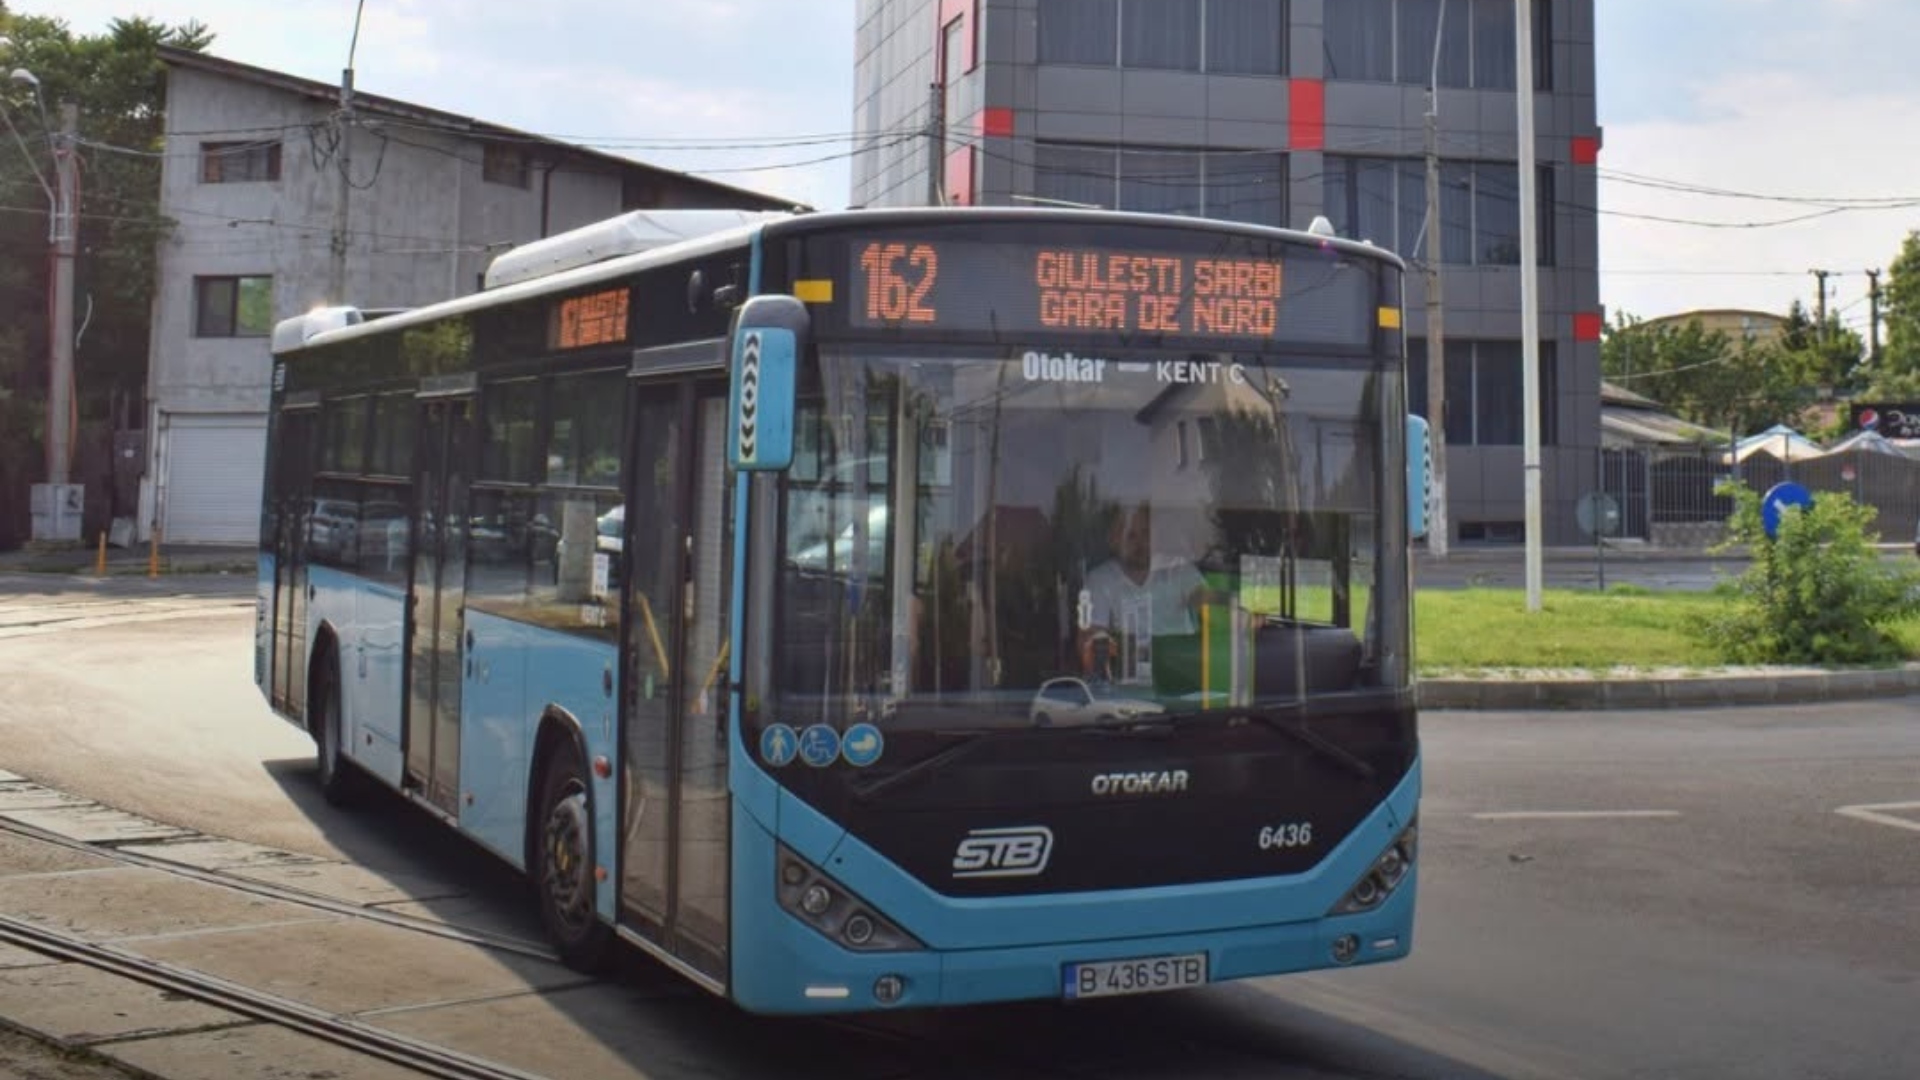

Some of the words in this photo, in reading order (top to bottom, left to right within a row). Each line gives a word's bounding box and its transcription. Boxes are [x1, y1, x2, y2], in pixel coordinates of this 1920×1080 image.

[861, 242, 938, 320] 162
[1036, 251, 1182, 292] GIULESTI
[1194, 260, 1281, 298] SARBI
[1040, 290, 1126, 328] GARA
[1138, 295, 1180, 331] DE
[1194, 298, 1276, 334] NORD
[1022, 351, 1105, 381] Otokar
[1156, 360, 1220, 383] KENT
[1229, 363, 1246, 384] C
[1091, 770, 1188, 794] OTOKAR
[953, 835, 1043, 869] STB
[1259, 823, 1312, 849] 6436
[1080, 967, 1096, 993] B
[1108, 963, 1149, 990] 436
[1153, 958, 1200, 985] STB
